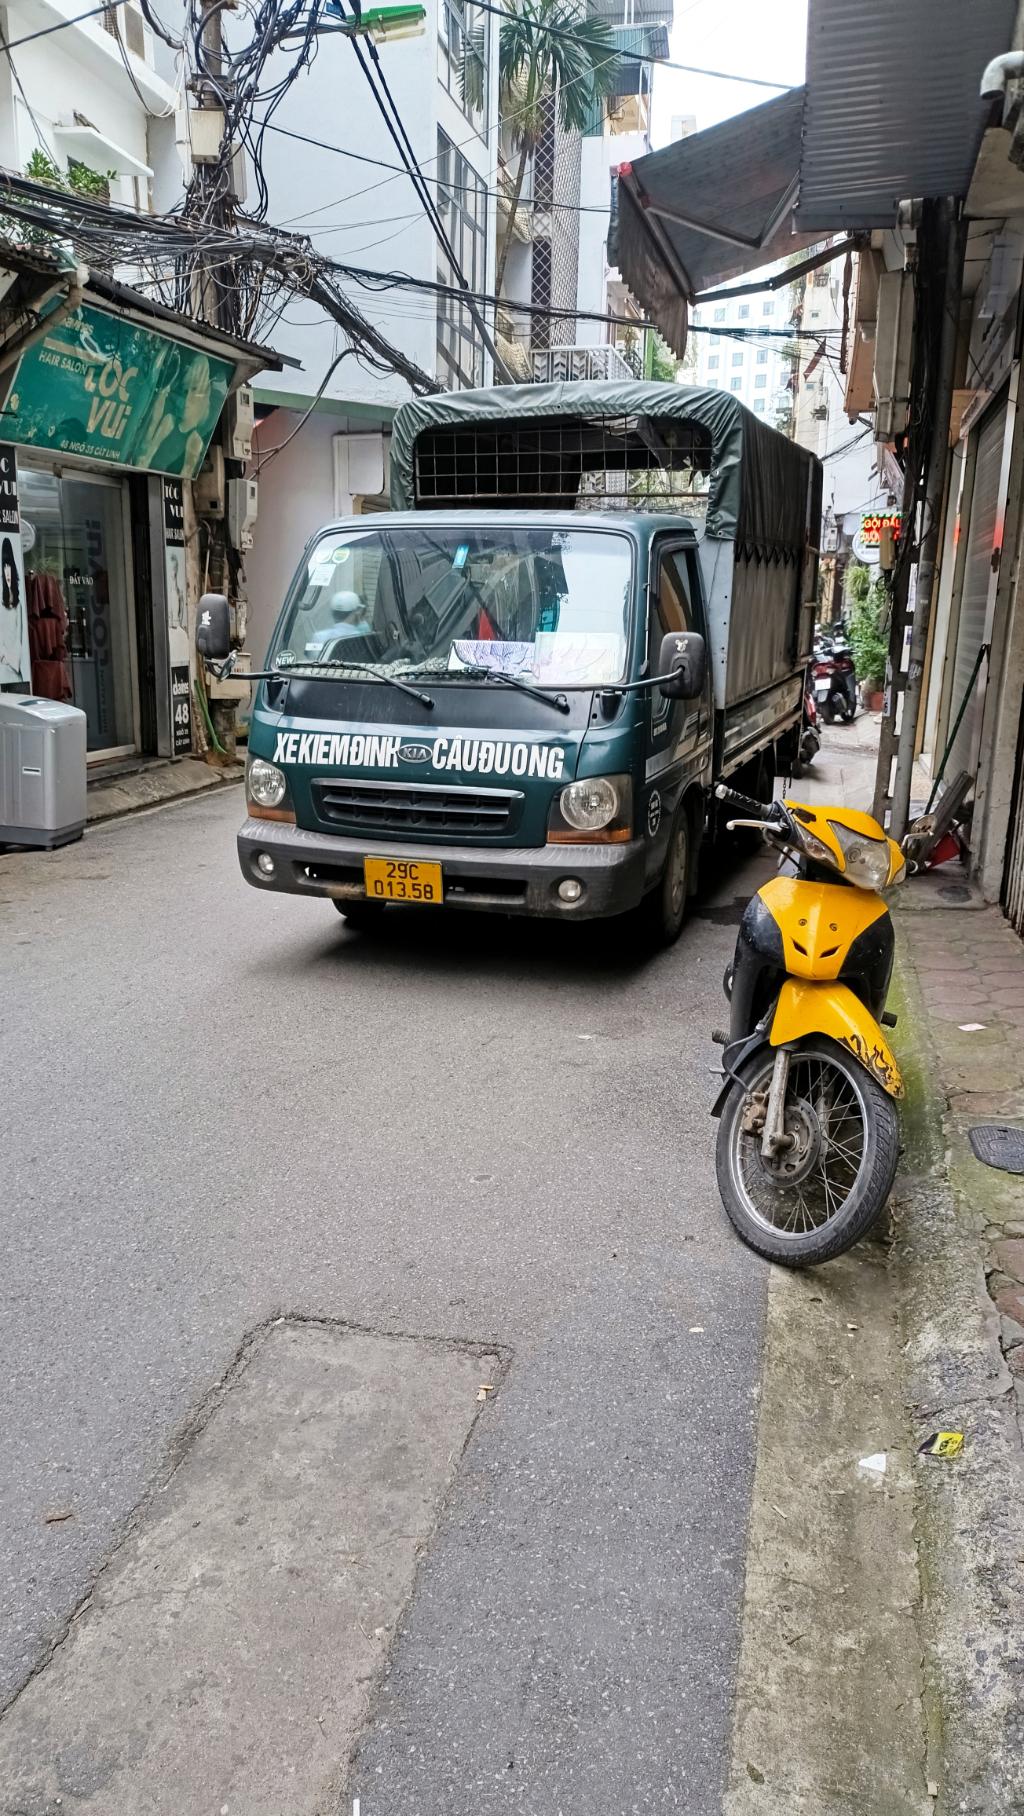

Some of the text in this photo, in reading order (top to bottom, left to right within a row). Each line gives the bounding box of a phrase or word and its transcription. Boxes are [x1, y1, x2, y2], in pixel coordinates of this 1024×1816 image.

[39, 350, 89, 376] HAIR SALON
[275, 656, 295, 666] NEW
[175, 703, 189, 724] 48
[402, 747, 427, 759] KIA
[386, 862, 419, 880] 29C
[374, 880, 433, 900] 013.58
